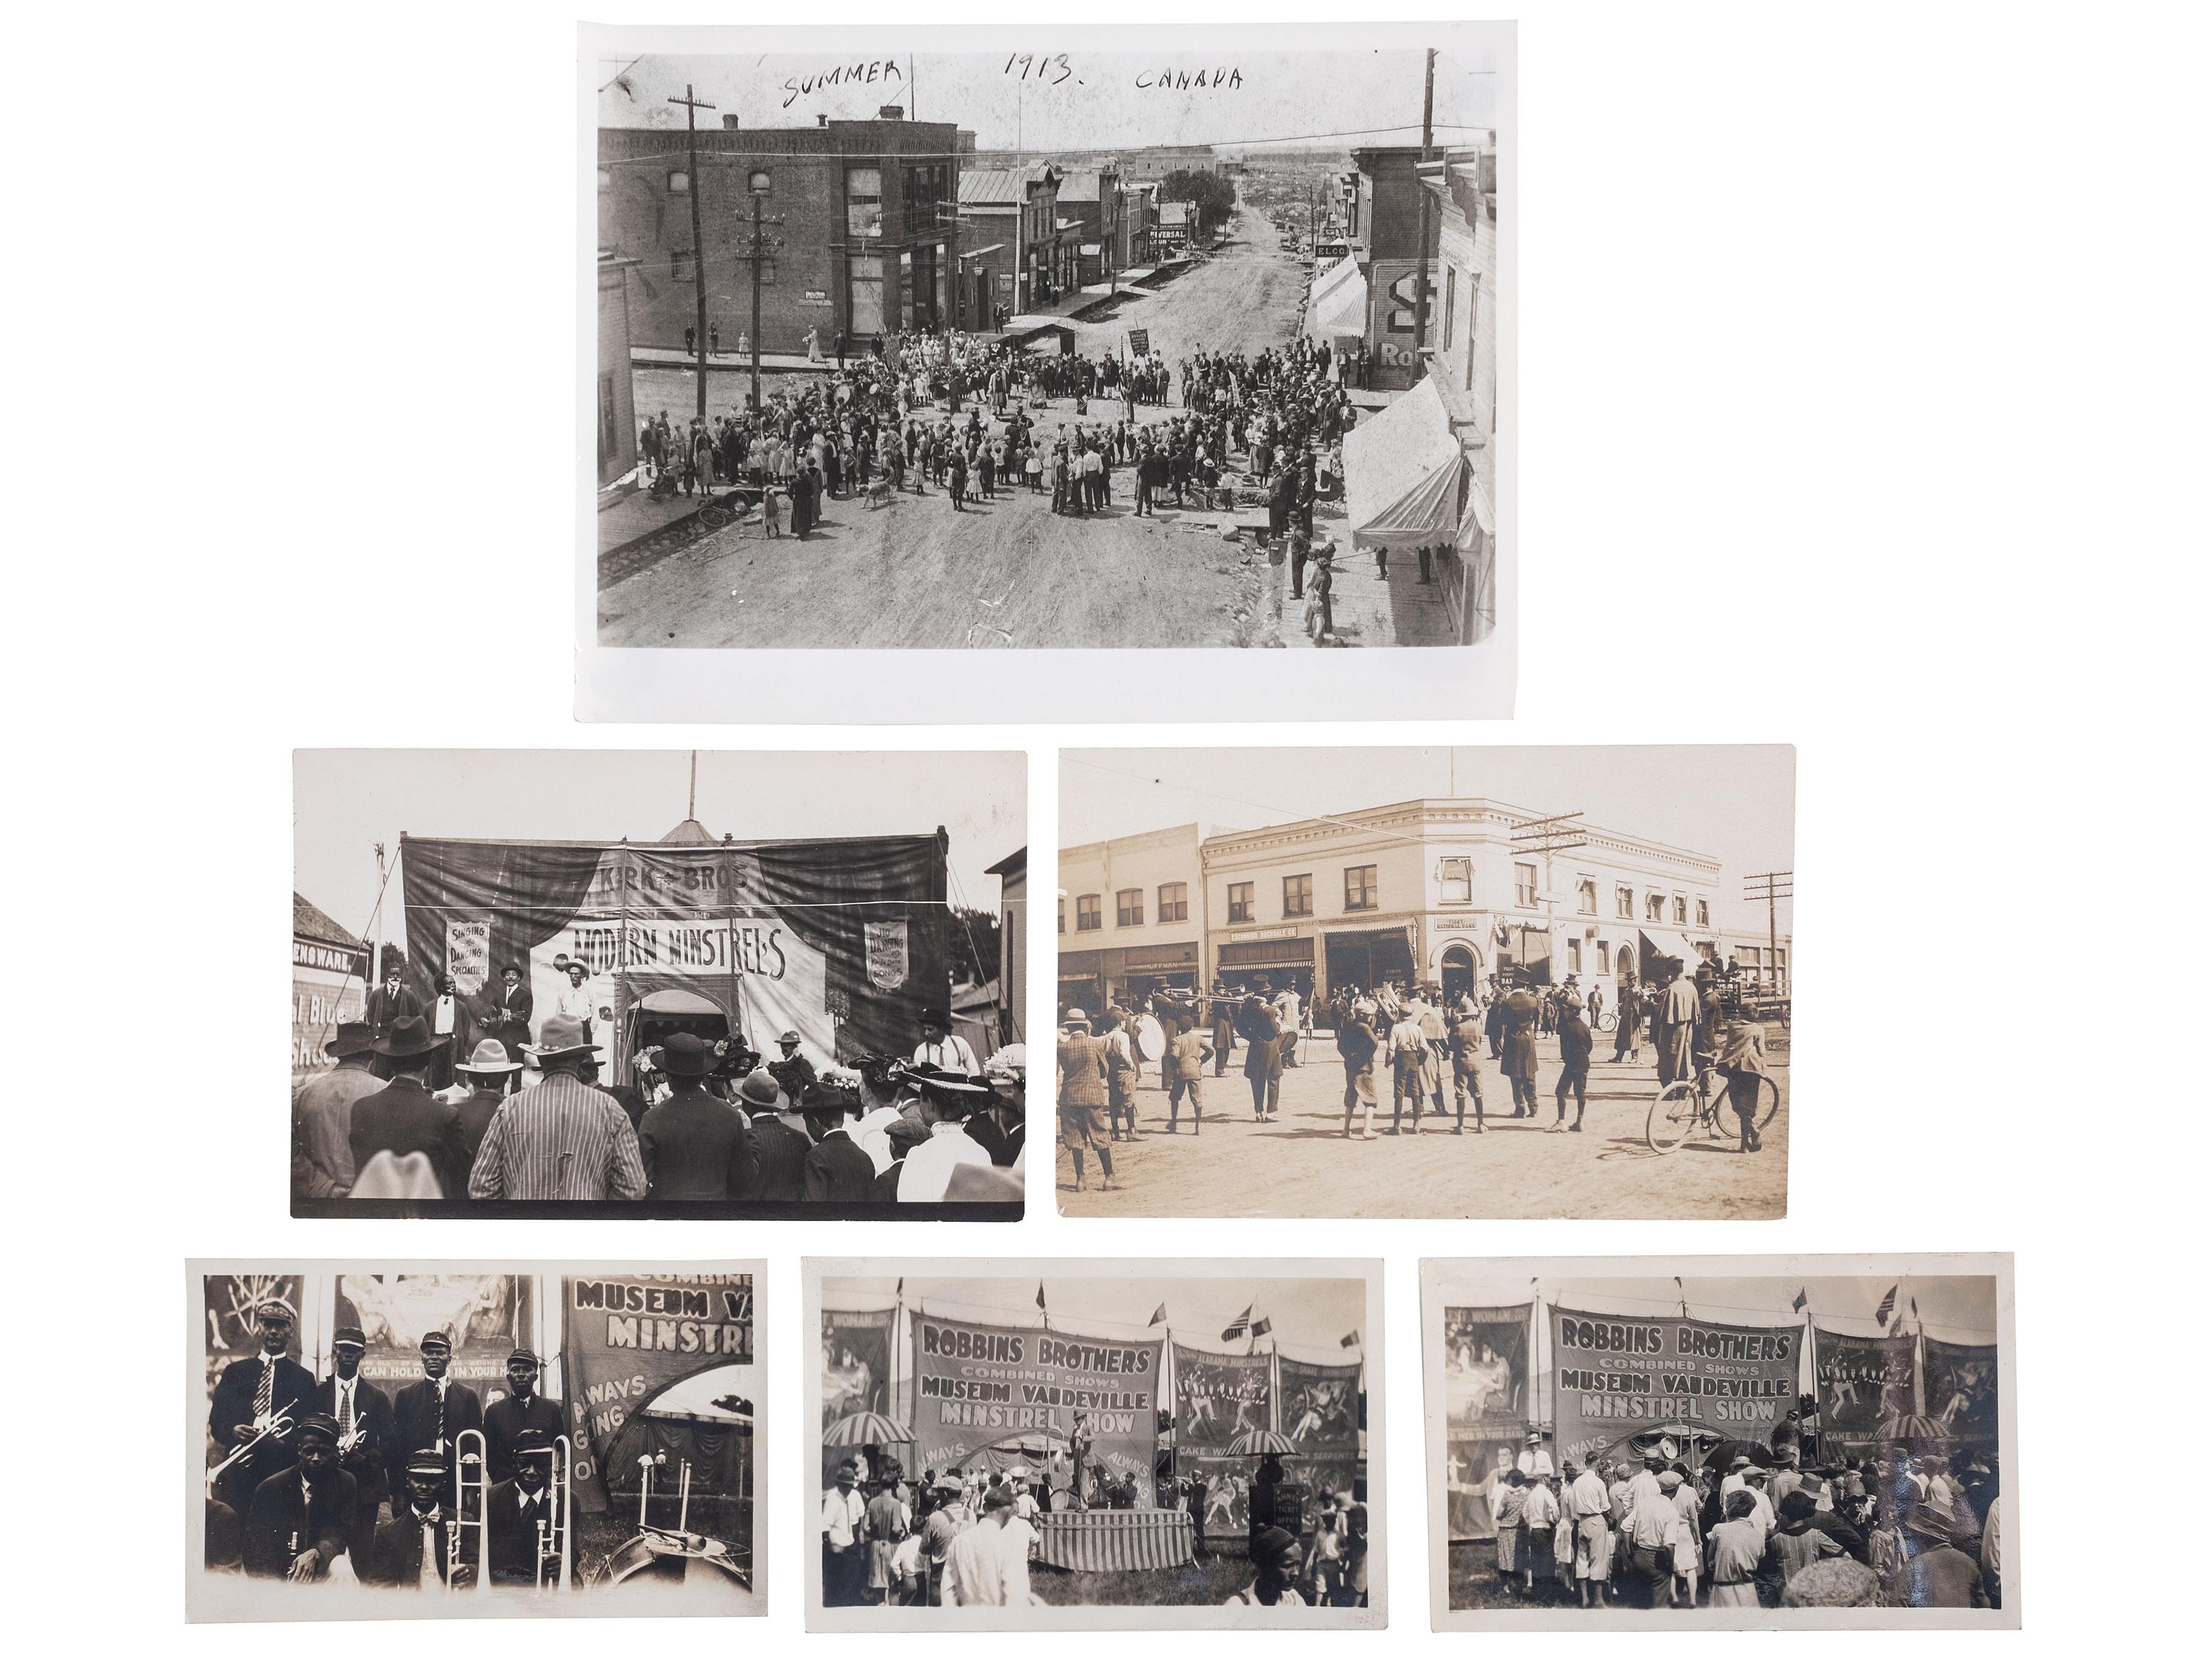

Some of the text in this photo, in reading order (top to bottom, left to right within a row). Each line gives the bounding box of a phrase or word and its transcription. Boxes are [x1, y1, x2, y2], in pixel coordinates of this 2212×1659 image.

[783, 60, 901, 108] SUMMER
[1135, 66, 1244, 91] CANADA
[684, 864, 748, 890] BROS
[452, 927, 485, 941] SINGING
[869, 937, 904, 953] DANCING
[451, 947, 482, 963] DANCING
[574, 927, 658, 976] MODERN
[451, 965, 485, 975] SPECIALTIES
[874, 968, 903, 978] SONGS
[574, 1278, 712, 1320] MUSEUM
[922, 1324, 1152, 1375] ROBBINS BROTHERS
[1559, 1316, 1792, 1362] ROBBINS BROTHERS
[363, 1367, 422, 1377] CAN HOLD
[454, 1367, 467, 1377] IN
[470, 1367, 497, 1377] YOUR
[960, 1366, 1120, 1388] COMBINED SHOWS
[1598, 1357, 1760, 1377] COMBINED SHOWS
[919, 1374, 1150, 1411] MUSEUM VAUDEVILLE
[1559, 1368, 1792, 1399] MUSEUM VAUDEVILLE
[939, 1401, 1135, 1433] MINSTREL HOW
[1580, 1393, 1778, 1422] MINSTREL SHOW
[1825, 1432, 1851, 1441] CAKE
[1180, 1447, 1206, 1456] CAKE
[1107, 1451, 1150, 1478] ALWAYS
